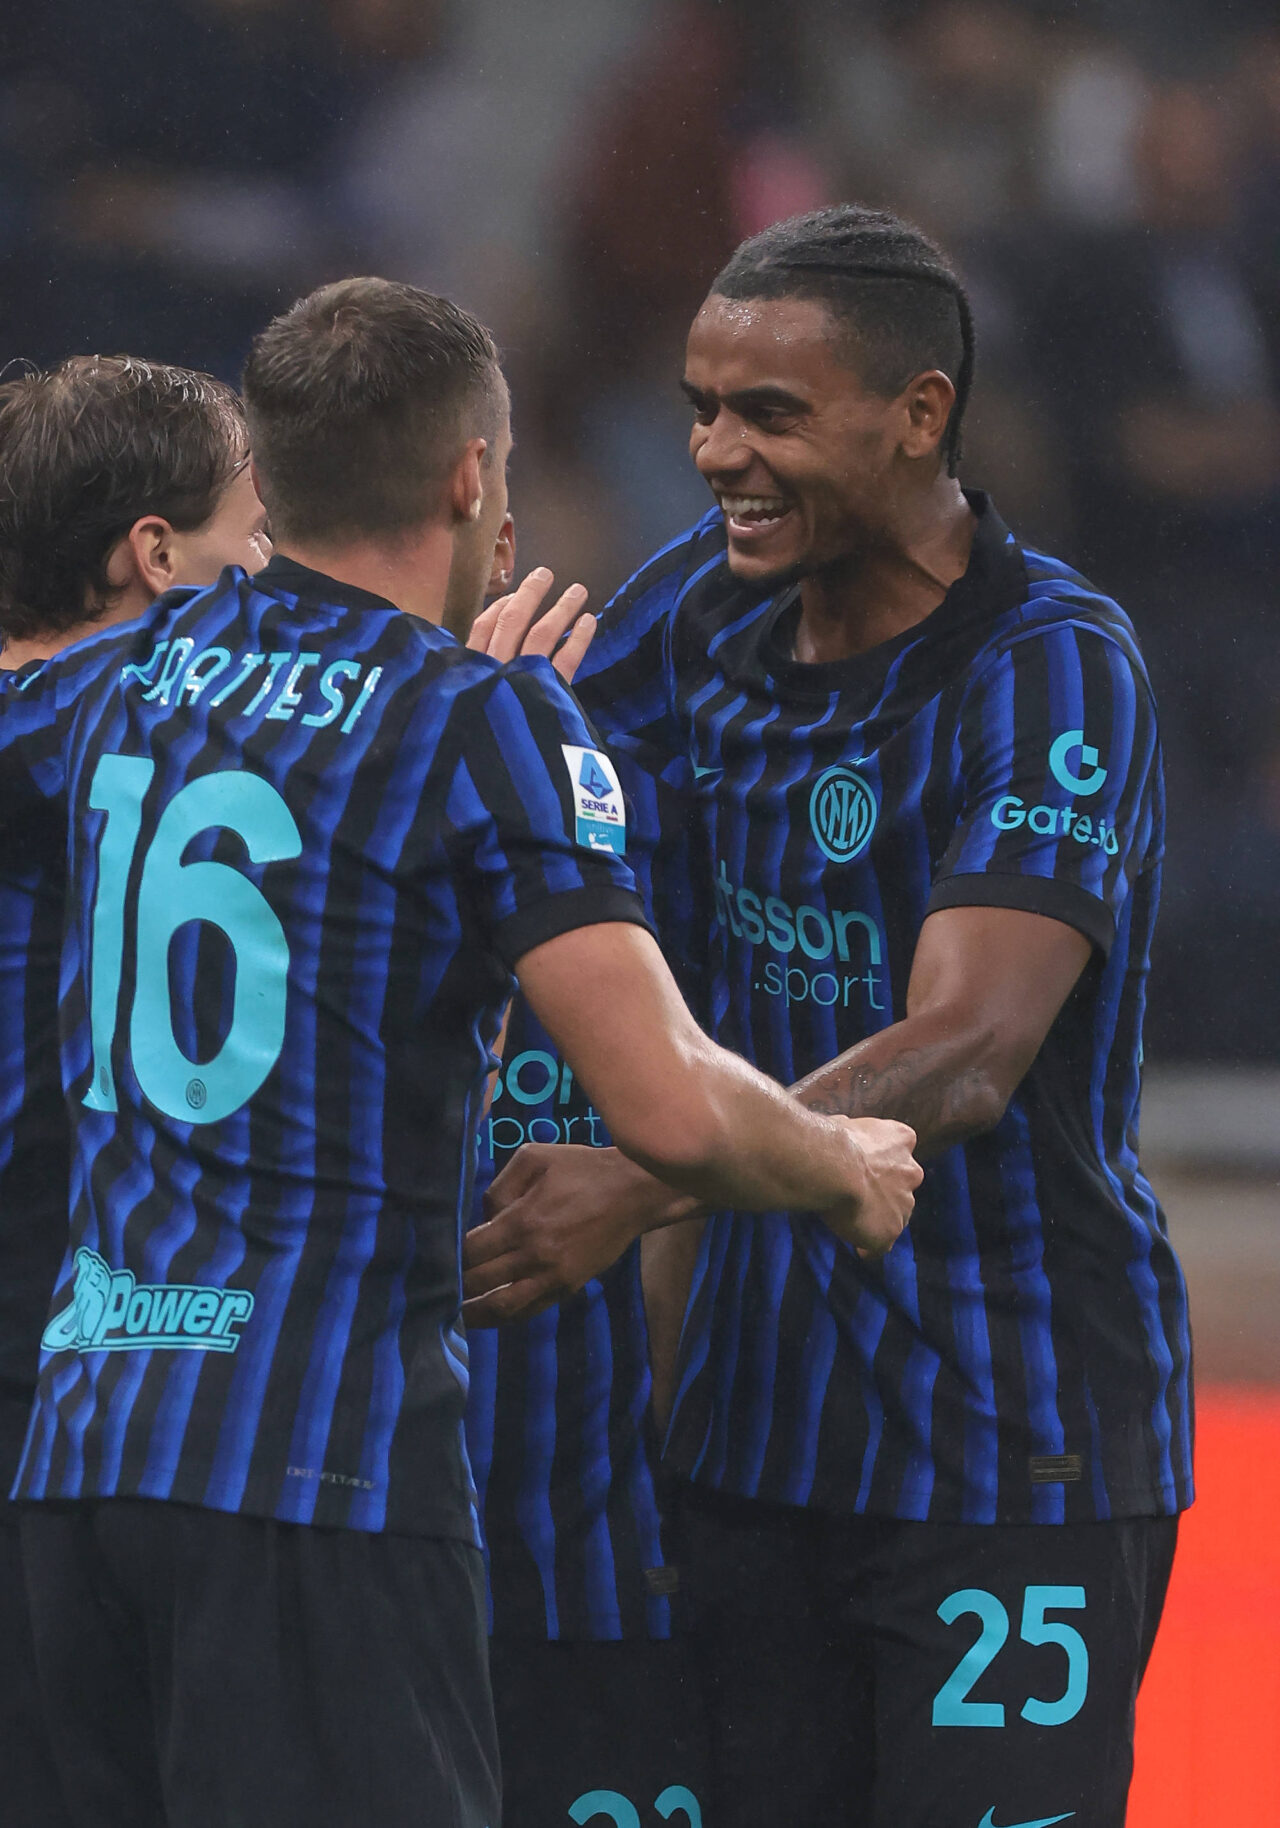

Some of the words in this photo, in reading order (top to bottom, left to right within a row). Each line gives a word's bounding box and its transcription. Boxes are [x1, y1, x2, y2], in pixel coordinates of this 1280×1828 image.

[581, 798, 609, 814] SERIE
[611, 804, 619, 815] A
[990, 795, 1119, 855] Gate.io
[81, 753, 303, 1125] 16
[476, 1106, 603, 1160] port
[932, 1585, 1090, 1728] 25
